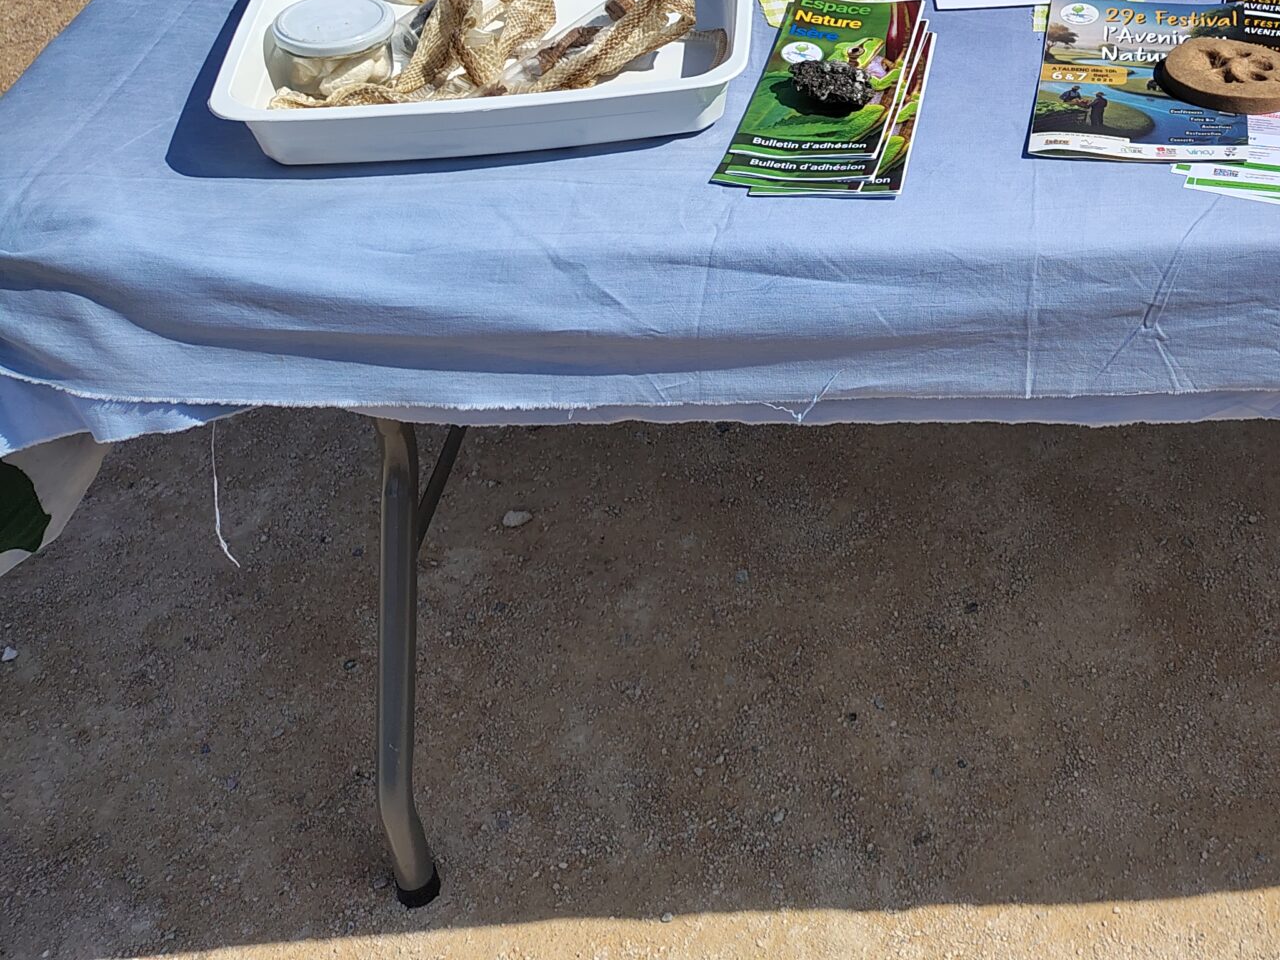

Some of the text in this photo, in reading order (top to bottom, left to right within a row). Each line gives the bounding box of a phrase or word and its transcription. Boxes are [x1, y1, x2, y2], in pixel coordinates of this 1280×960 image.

[795, 9, 862, 29] Nature
[1104, 7, 1238, 27] 29e Festival
[1244, 18, 1251, 26] E
[789, 23, 839, 42] Isère
[1103, 25, 1193, 45] l'Avenir
[1052, 71, 1063, 80] 6
[1076, 72, 1087, 81] 7
[752, 136, 867, 149] Bulletin d'adhésion
[750, 158, 866, 171] Bulletin d'adhésion
